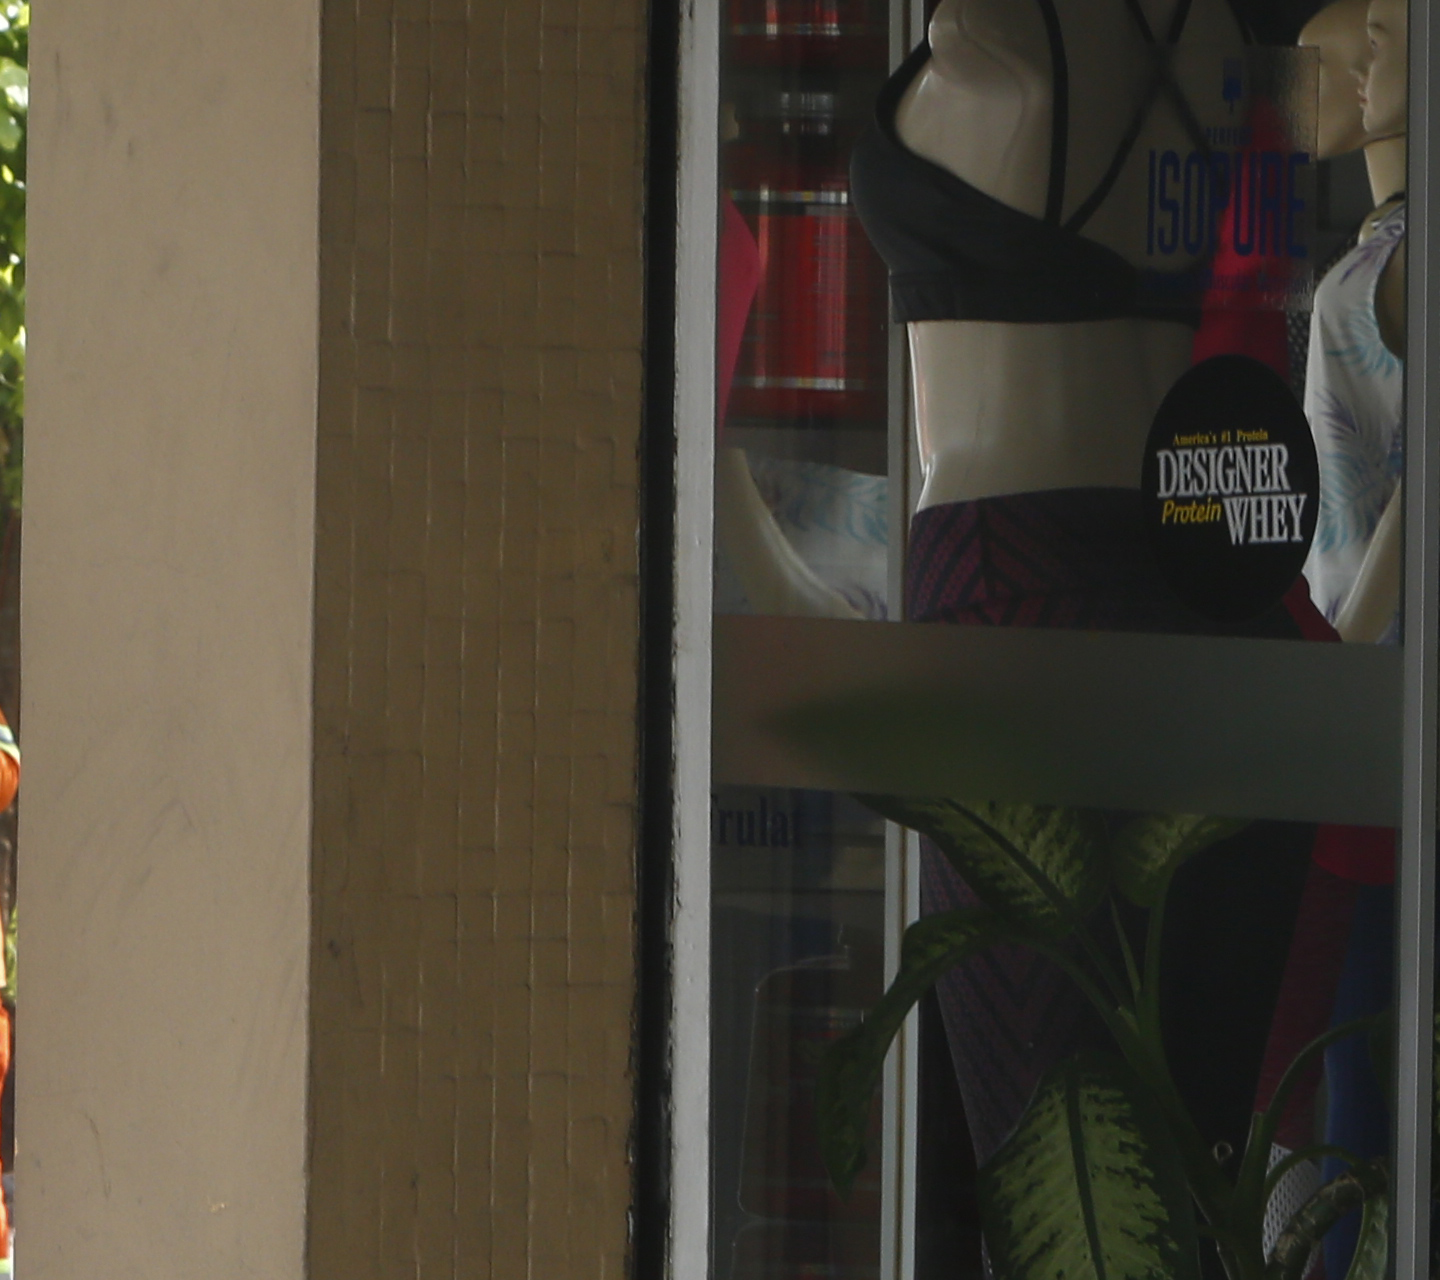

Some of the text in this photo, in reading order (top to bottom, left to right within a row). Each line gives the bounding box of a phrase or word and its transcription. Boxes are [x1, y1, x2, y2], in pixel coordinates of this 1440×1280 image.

[1147, 149, 1311, 259] ISOPURE
[1156, 443, 1292, 499] DESIGNER
[1162, 493, 1308, 546] Protein WHEY
